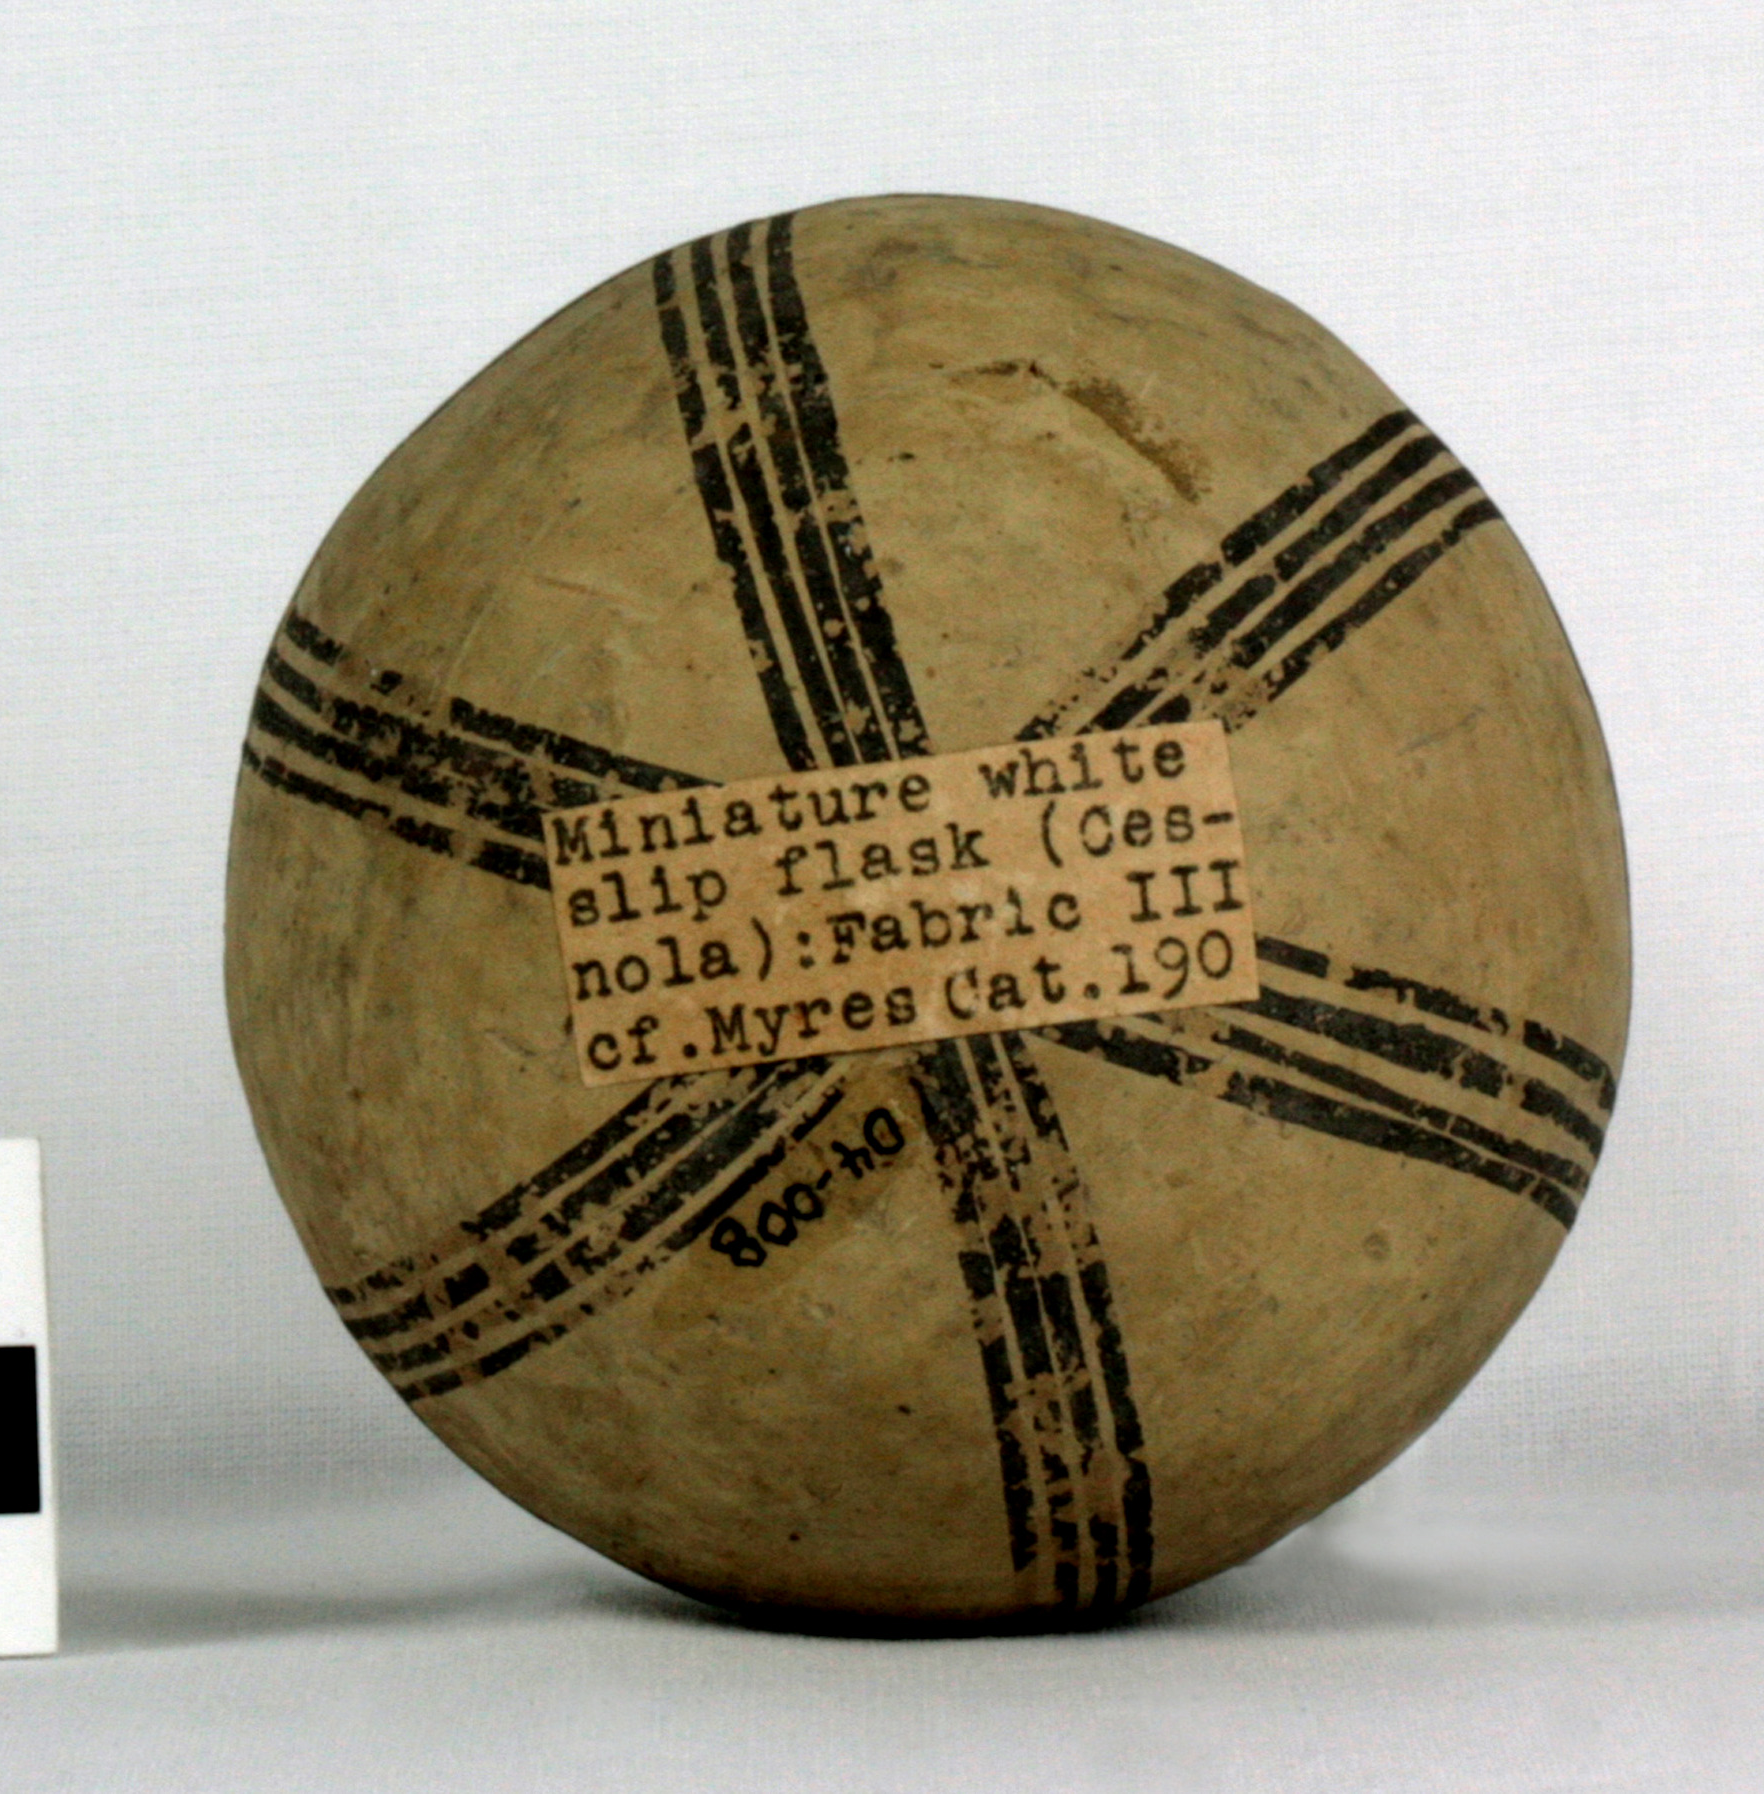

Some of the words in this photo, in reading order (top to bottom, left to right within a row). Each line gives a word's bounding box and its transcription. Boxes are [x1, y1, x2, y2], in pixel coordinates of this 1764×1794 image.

[553, 772, 933, 867] Miniature
[979, 738, 1188, 801] white
[570, 866, 728, 928] slip
[776, 823, 990, 897] flask
[1042, 800, 1234, 868] (Ces-
[1129, 860, 1244, 924] III
